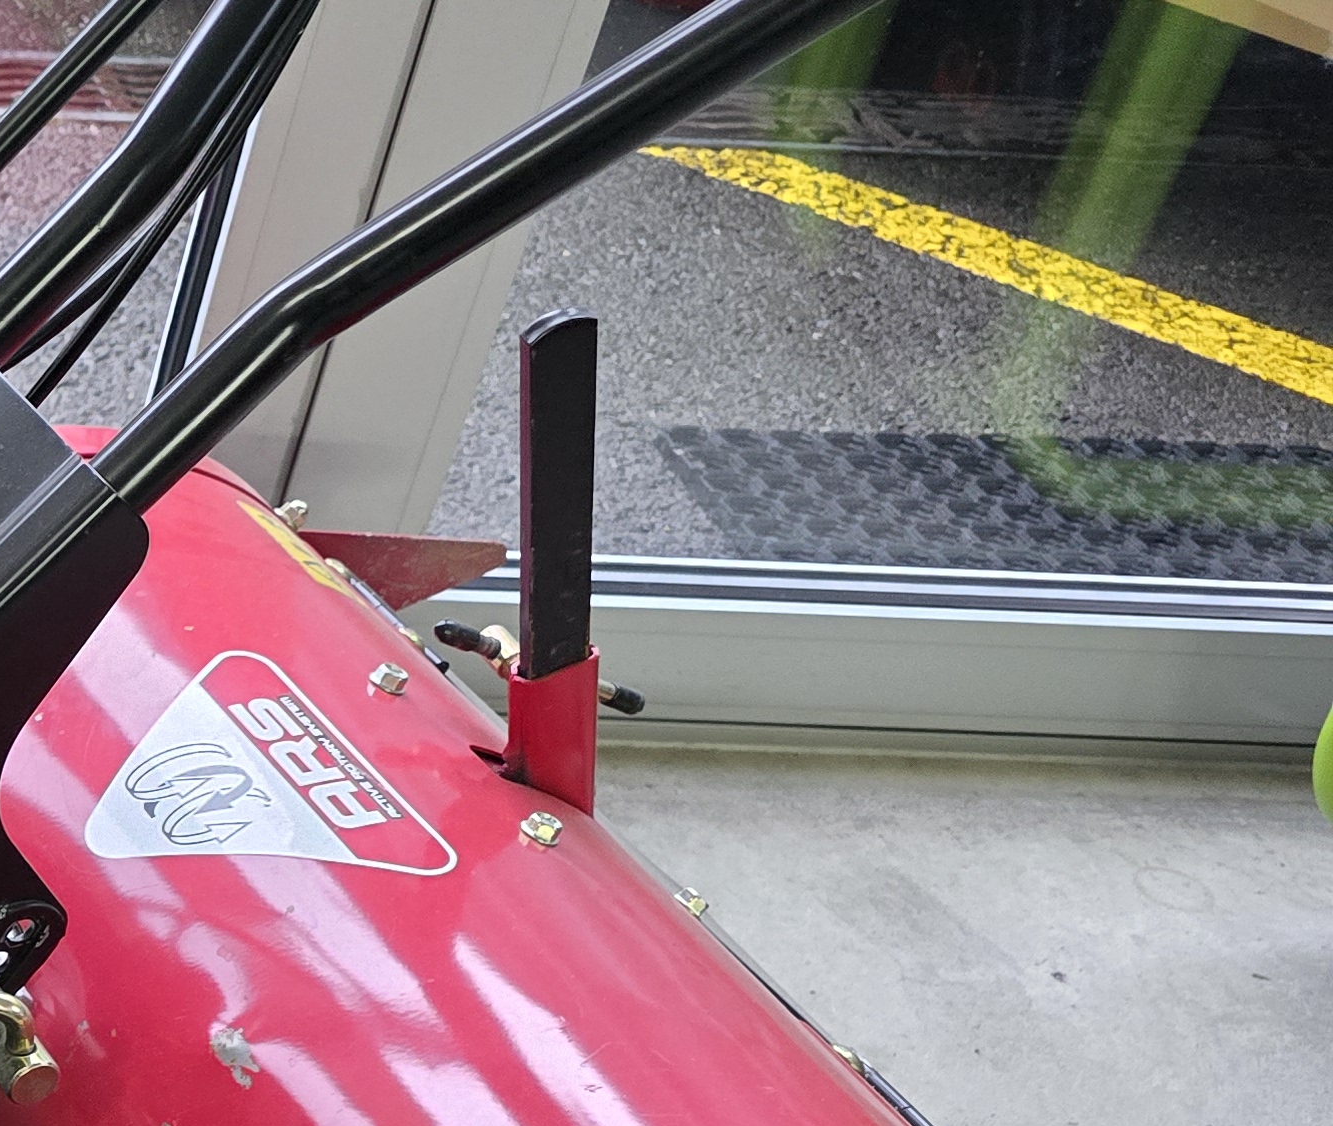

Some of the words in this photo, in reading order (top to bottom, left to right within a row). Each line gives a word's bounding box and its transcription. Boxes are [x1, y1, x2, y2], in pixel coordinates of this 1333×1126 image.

[278, 695, 325, 738] SYSTEM
[227, 697, 387, 829] ARS
[317, 736, 365, 780] ROTARY
[358, 780, 401, 819] ACTIVE
